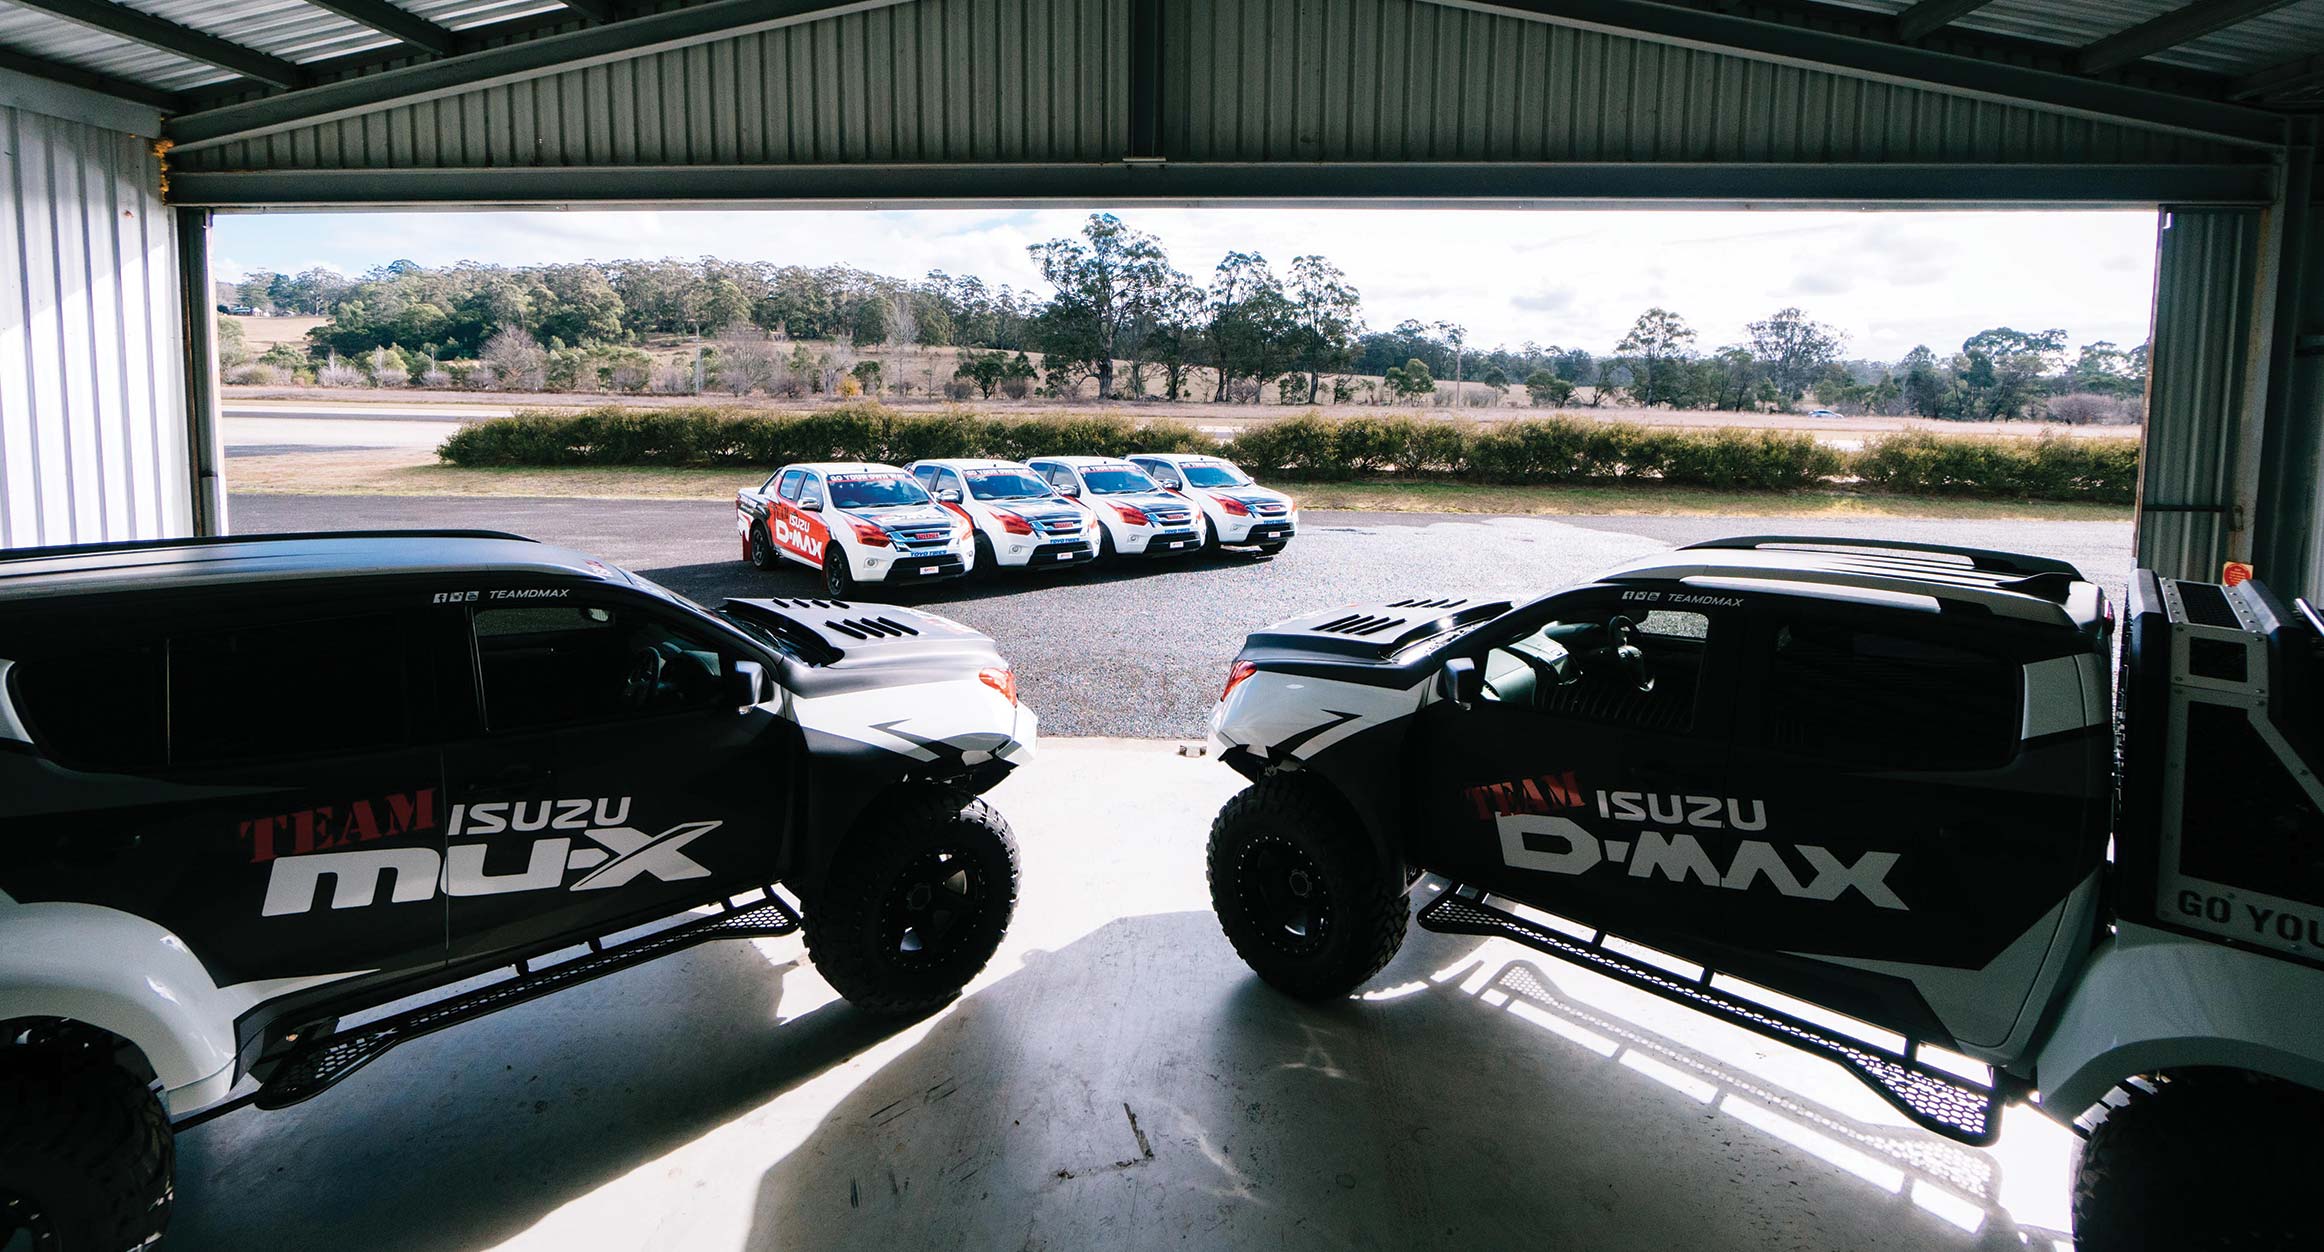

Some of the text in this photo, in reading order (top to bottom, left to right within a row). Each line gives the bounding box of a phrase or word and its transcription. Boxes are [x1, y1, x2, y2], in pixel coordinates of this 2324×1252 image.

[775, 523, 823, 561] D-MAX
[789, 513, 810, 533] ISUZU
[489, 588, 570, 600] TEAMDMAX
[1667, 593, 1745, 607] TEAMDMAX
[447, 796, 632, 836] ISUZU
[1465, 773, 1586, 821] TEAM
[1596, 789, 1767, 831] ISUZU
[240, 788, 435, 863] TEAM
[1495, 811, 1910, 911] D-MAX
[2178, 890, 2231, 923] GO
